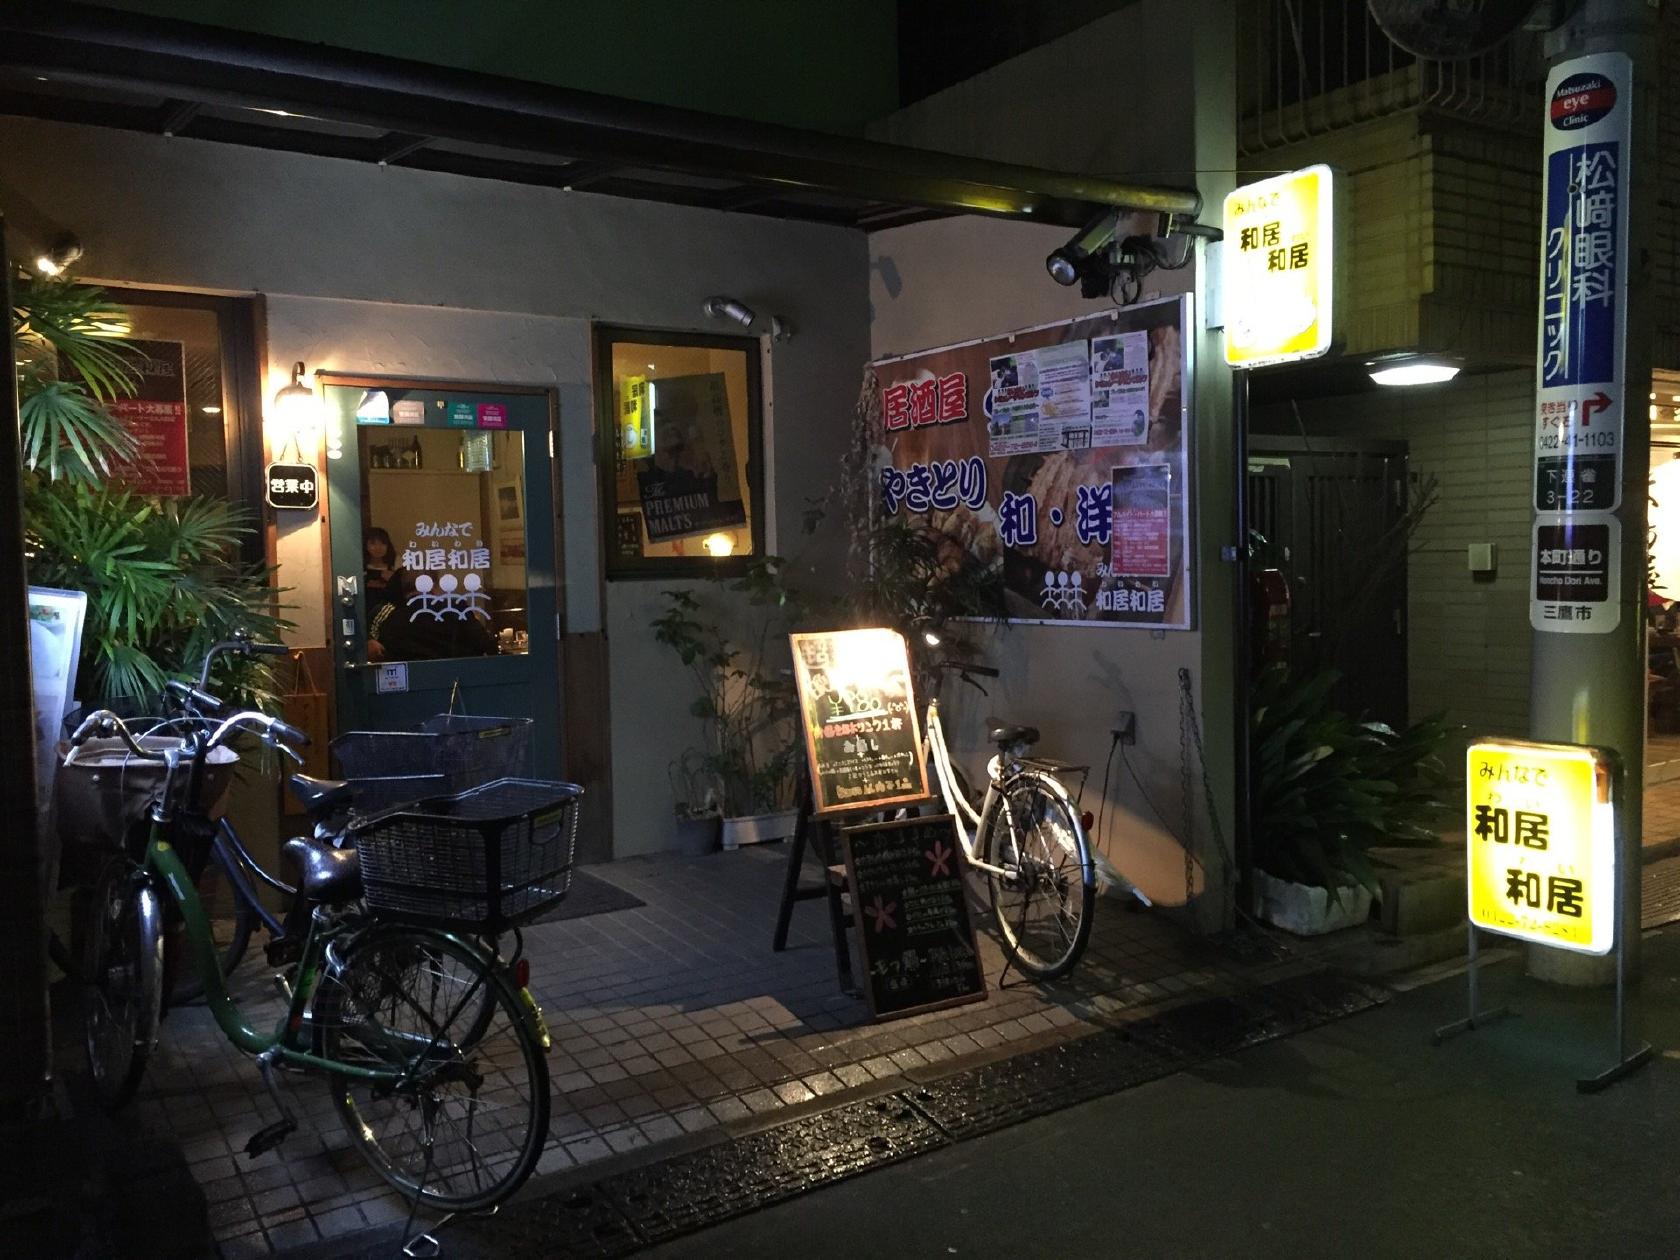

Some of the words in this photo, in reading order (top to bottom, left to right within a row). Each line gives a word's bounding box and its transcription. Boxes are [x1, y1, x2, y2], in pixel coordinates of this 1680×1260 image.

[1557, 80, 1602, 97] Matsuzaki
[1563, 94, 1590, 111] eye
[1563, 114, 1589, 127] Clinic
[1240, 221, 1280, 252] 和居
[1268, 242, 1309, 272] 和居
[1543, 228, 1567, 383] クリニック
[883, 372, 967, 431] 居酒屋
[271, 478, 315, 495] 営業中
[882, 456, 987, 515] やきとり
[1546, 490, 1595, 504] 3-22
[646, 492, 710, 516] PREMIUM
[416, 521, 474, 538] みんなで
[649, 513, 693, 534] MALTS
[402, 548, 490, 571] 和居和居
[1540, 549, 1602, 565] 本町通り
[1096, 589, 1166, 613] 和居和居
[1543, 606, 1592, 620] 三鷹市
[1479, 762, 1548, 787] みんなで
[1475, 805, 1549, 850] 和居
[1506, 869, 1583, 918] 和居
